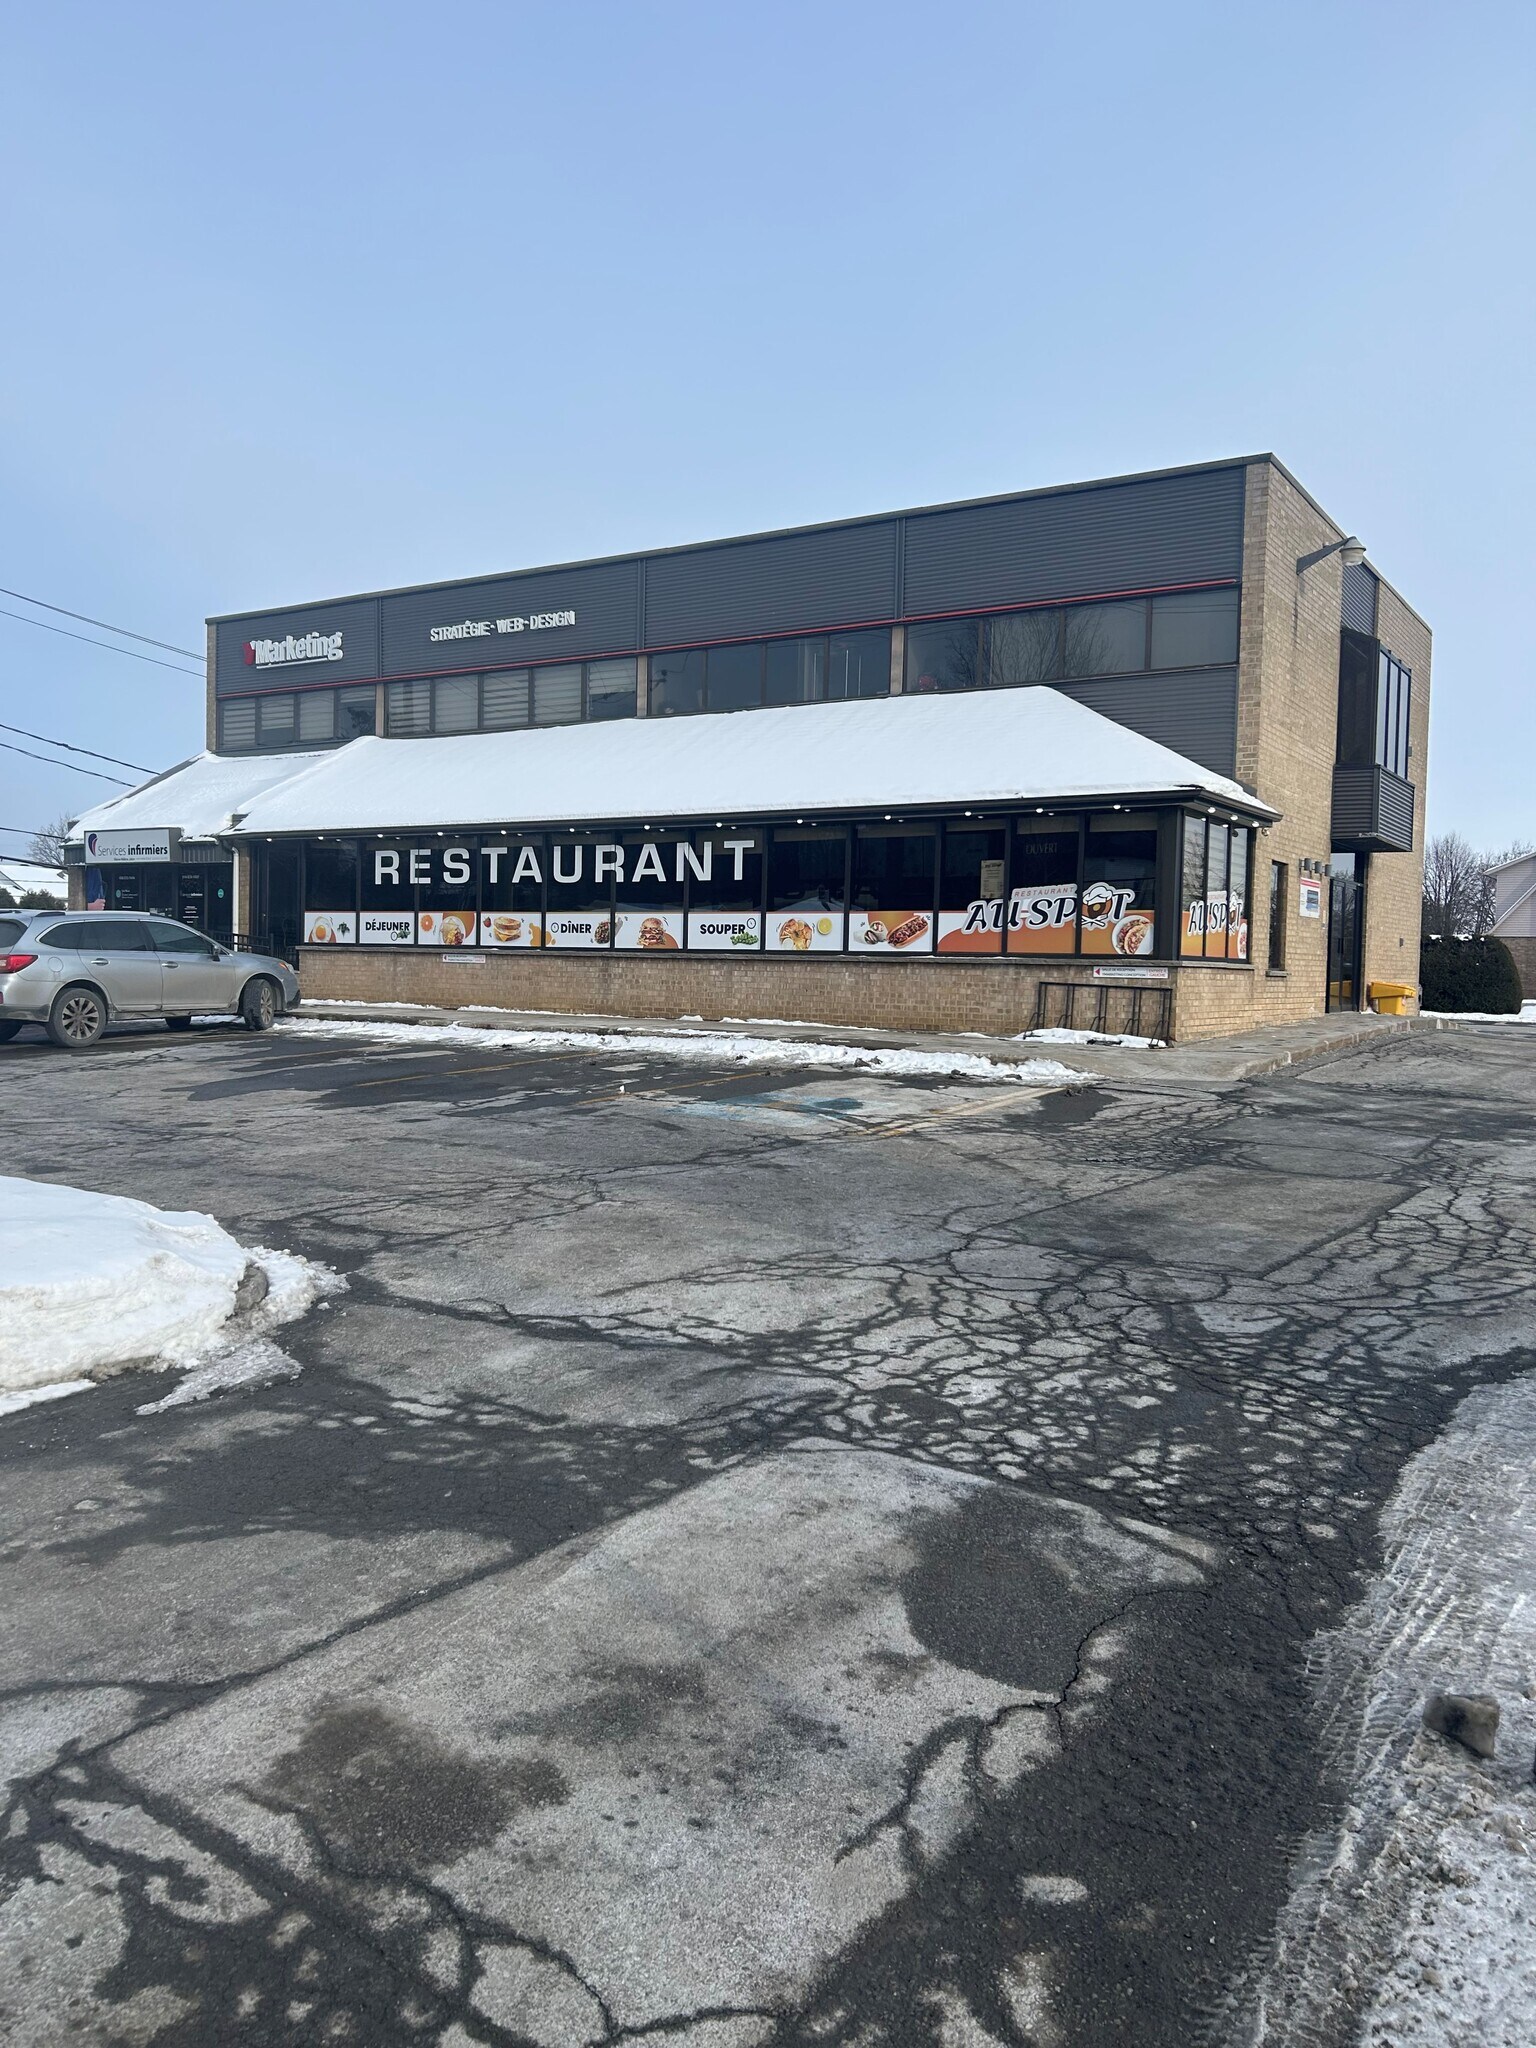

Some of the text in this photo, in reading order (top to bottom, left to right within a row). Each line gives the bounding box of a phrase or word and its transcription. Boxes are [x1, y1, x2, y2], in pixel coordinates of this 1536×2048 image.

[430, 610, 576, 642] STRATÉGIE WEB DESIGN
[97, 844, 168, 857] Services infirmiers
[374, 839, 755, 885] RESTAURANT
[1014, 886, 1075, 897] RESTAURANT
[365, 918, 410, 931] DÉJEUNER
[560, 920, 592, 934] DÎNER
[699, 923, 746, 935] SOUPER
